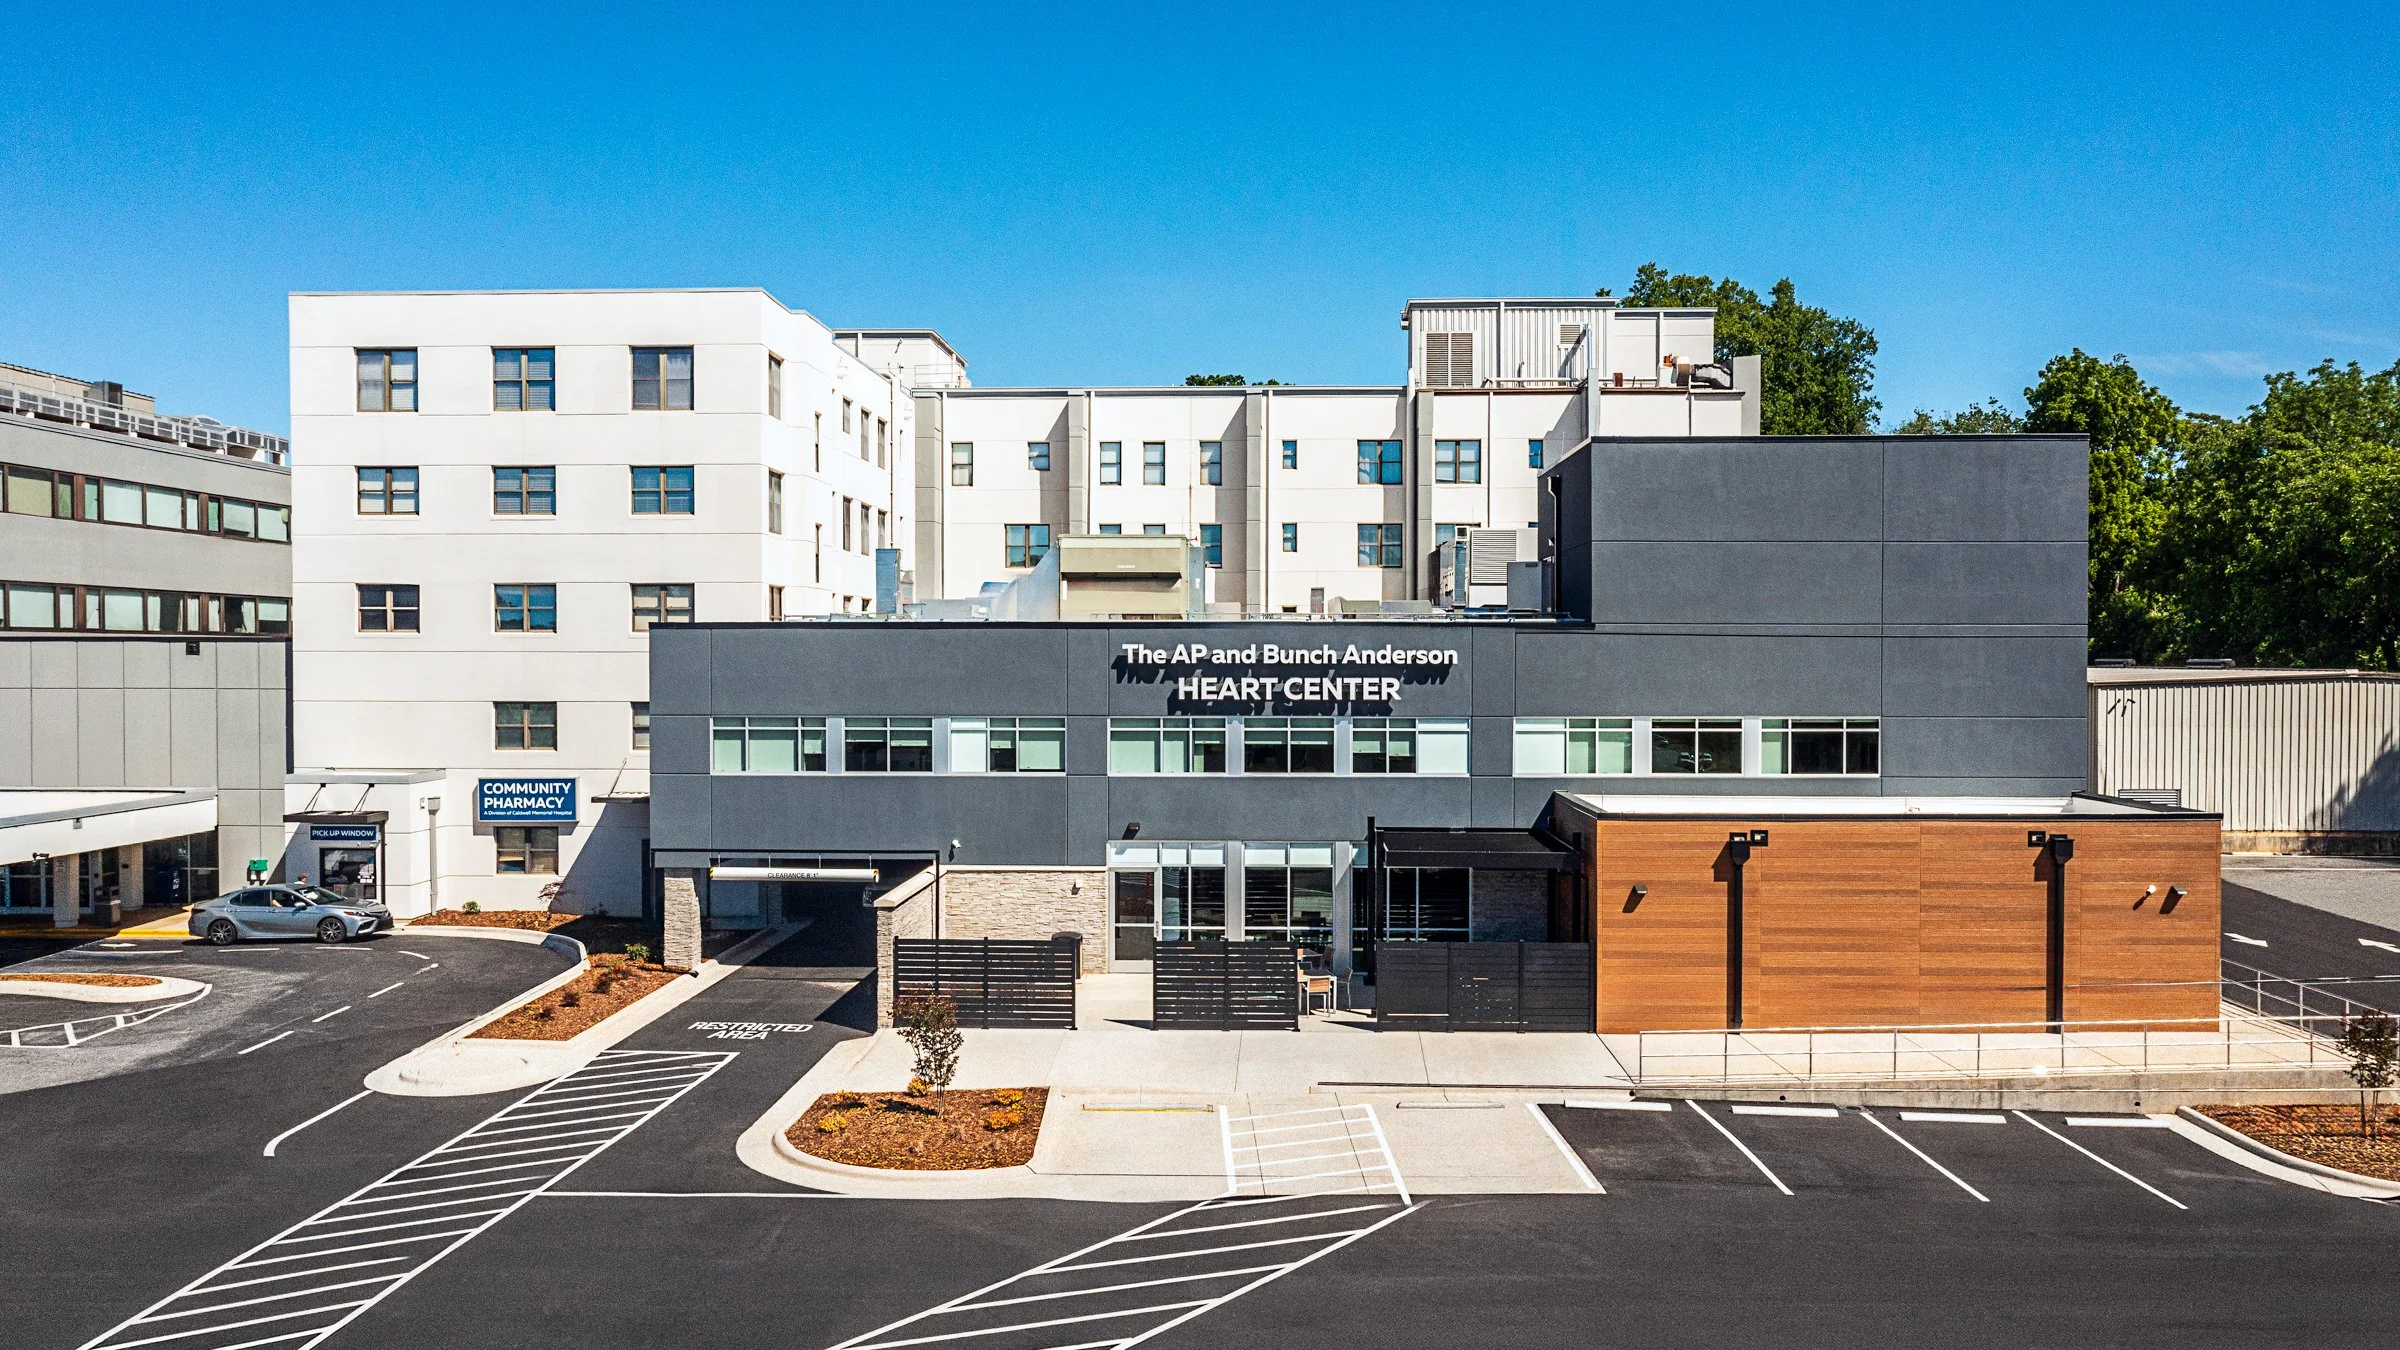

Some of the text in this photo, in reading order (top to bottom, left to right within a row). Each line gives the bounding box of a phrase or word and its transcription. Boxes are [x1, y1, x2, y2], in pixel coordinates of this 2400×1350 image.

[1122, 643, 1459, 665] The AP and Bunch Anderson
[1178, 676, 1402, 701] HEART CENTER
[484, 782, 571, 795] COMMUNITY
[484, 797, 565, 809] PHARMACY
[312, 829, 374, 837] PICK UP WINDOW
[687, 1021, 814, 1033] RESTRICTED
[706, 1030, 769, 1040] AREA
